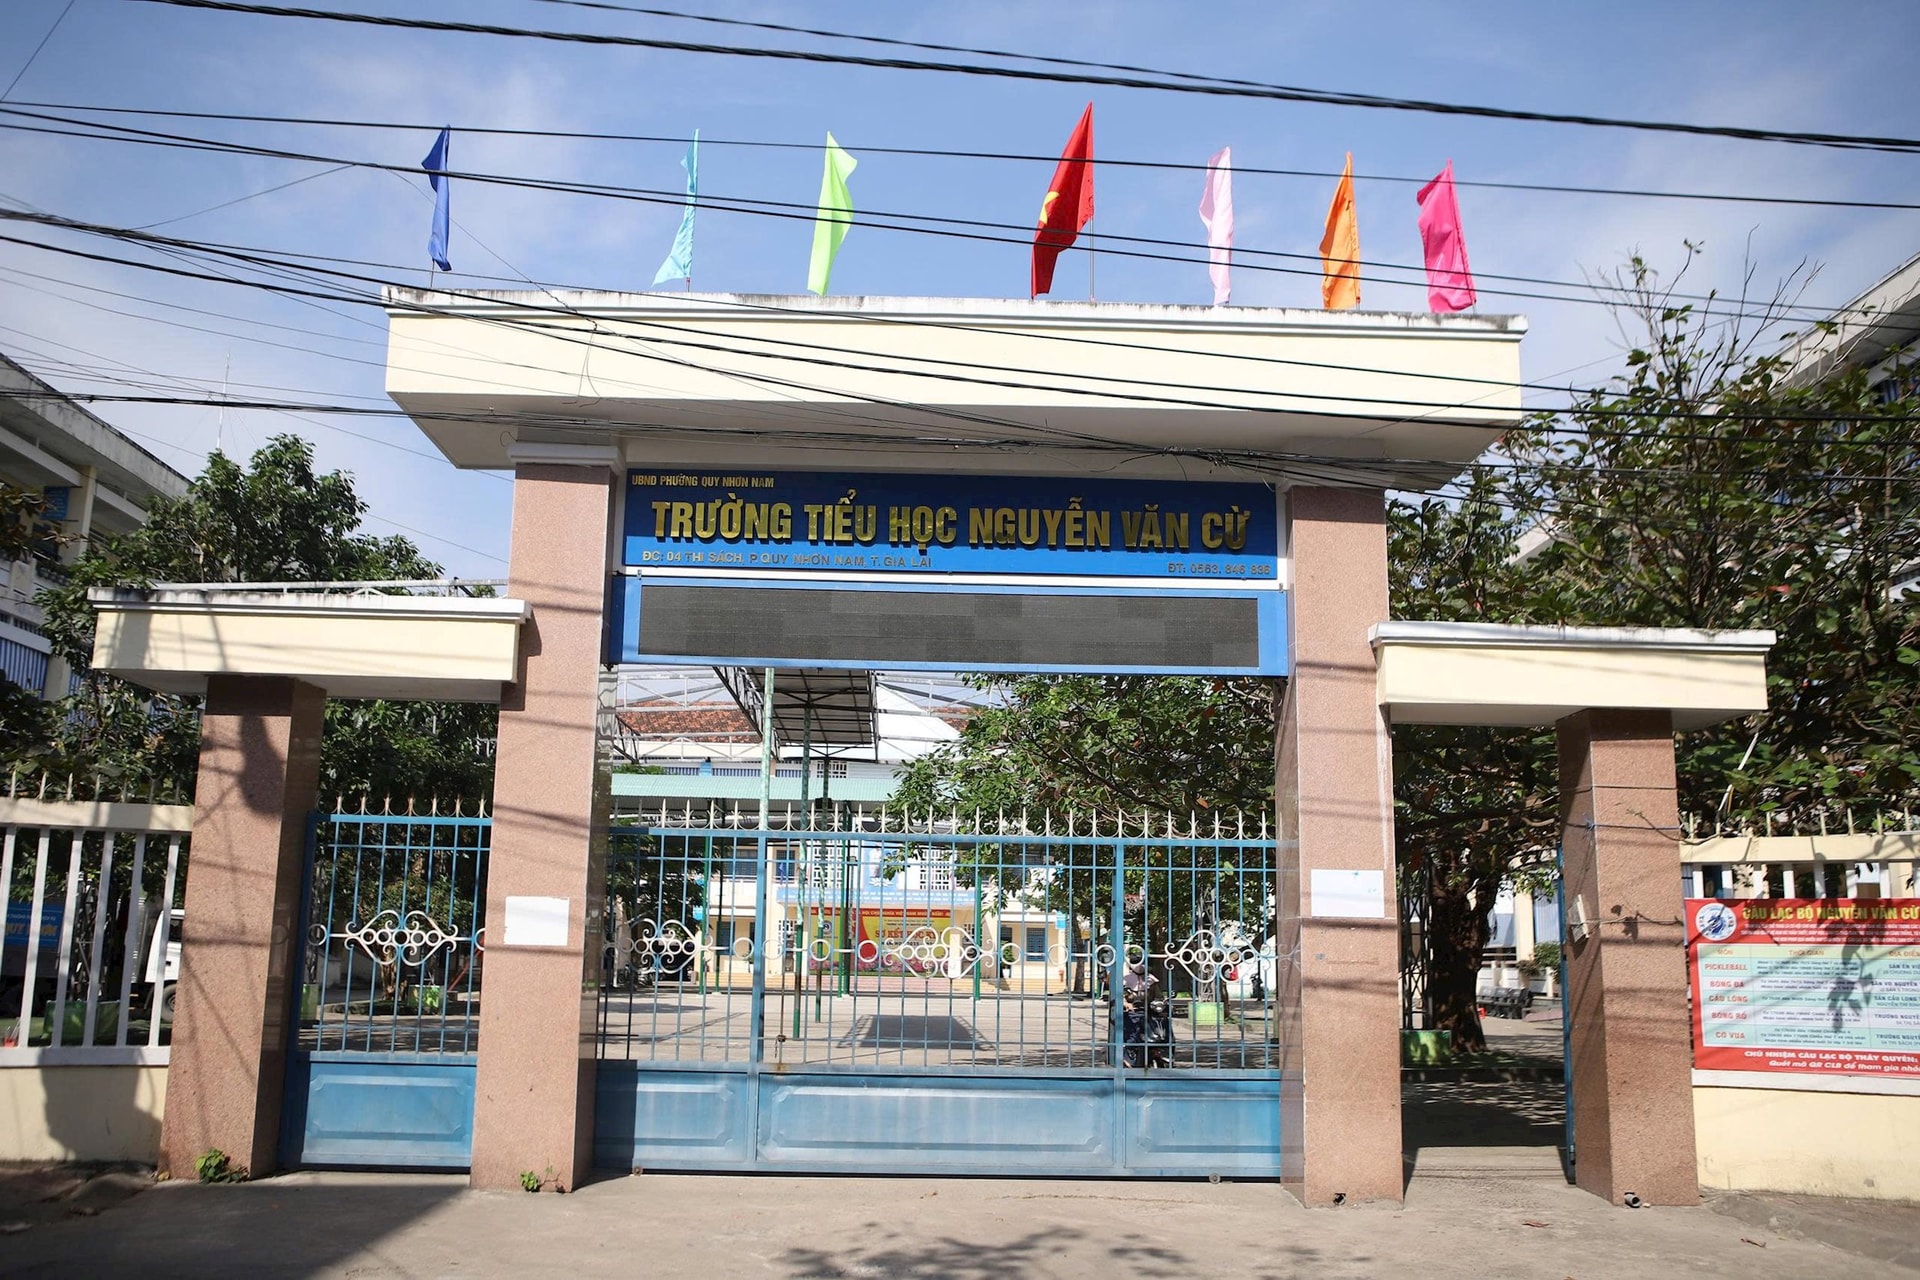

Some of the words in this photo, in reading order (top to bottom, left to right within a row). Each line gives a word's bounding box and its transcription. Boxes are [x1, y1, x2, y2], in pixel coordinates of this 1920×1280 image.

[632, 475, 657, 486] UBND
[660, 472, 698, 487] PHƯỜNG
[701, 476, 720, 488] QUY
[722, 475, 749, 488] NHƠN
[751, 477, 774, 488] NAM
[651, 492, 792, 539] TRƯỜNG
[803, 488, 877, 541] TIỂU
[888, 505, 958, 550] HỌC
[968, 496, 1110, 546] NGUYỄN
[1120, 503, 1190, 548] VĂN
[1201, 505, 1251, 550] CỪ
[642, 550, 664, 562] ĐC:
[666, 551, 682, 562] 04
[708, 549, 744, 565] SÁCH,
[793, 553, 830, 566] NHƠN
[835, 555, 867, 568] NAM,
[884, 556, 906, 568] GIA
[911, 557, 932, 568] LAI
[1168, 562, 1186, 573] ĐT:
[1796, 904, 1813, 922] BỘ
[1871, 904, 1897, 919] VĂN
[1704, 963, 1748, 971] PICKLEBALL
[1838, 1053, 1852, 1061] BỘ
[1858, 1062, 1882, 1070] tham
[1883, 1064, 1899, 1072] gia
